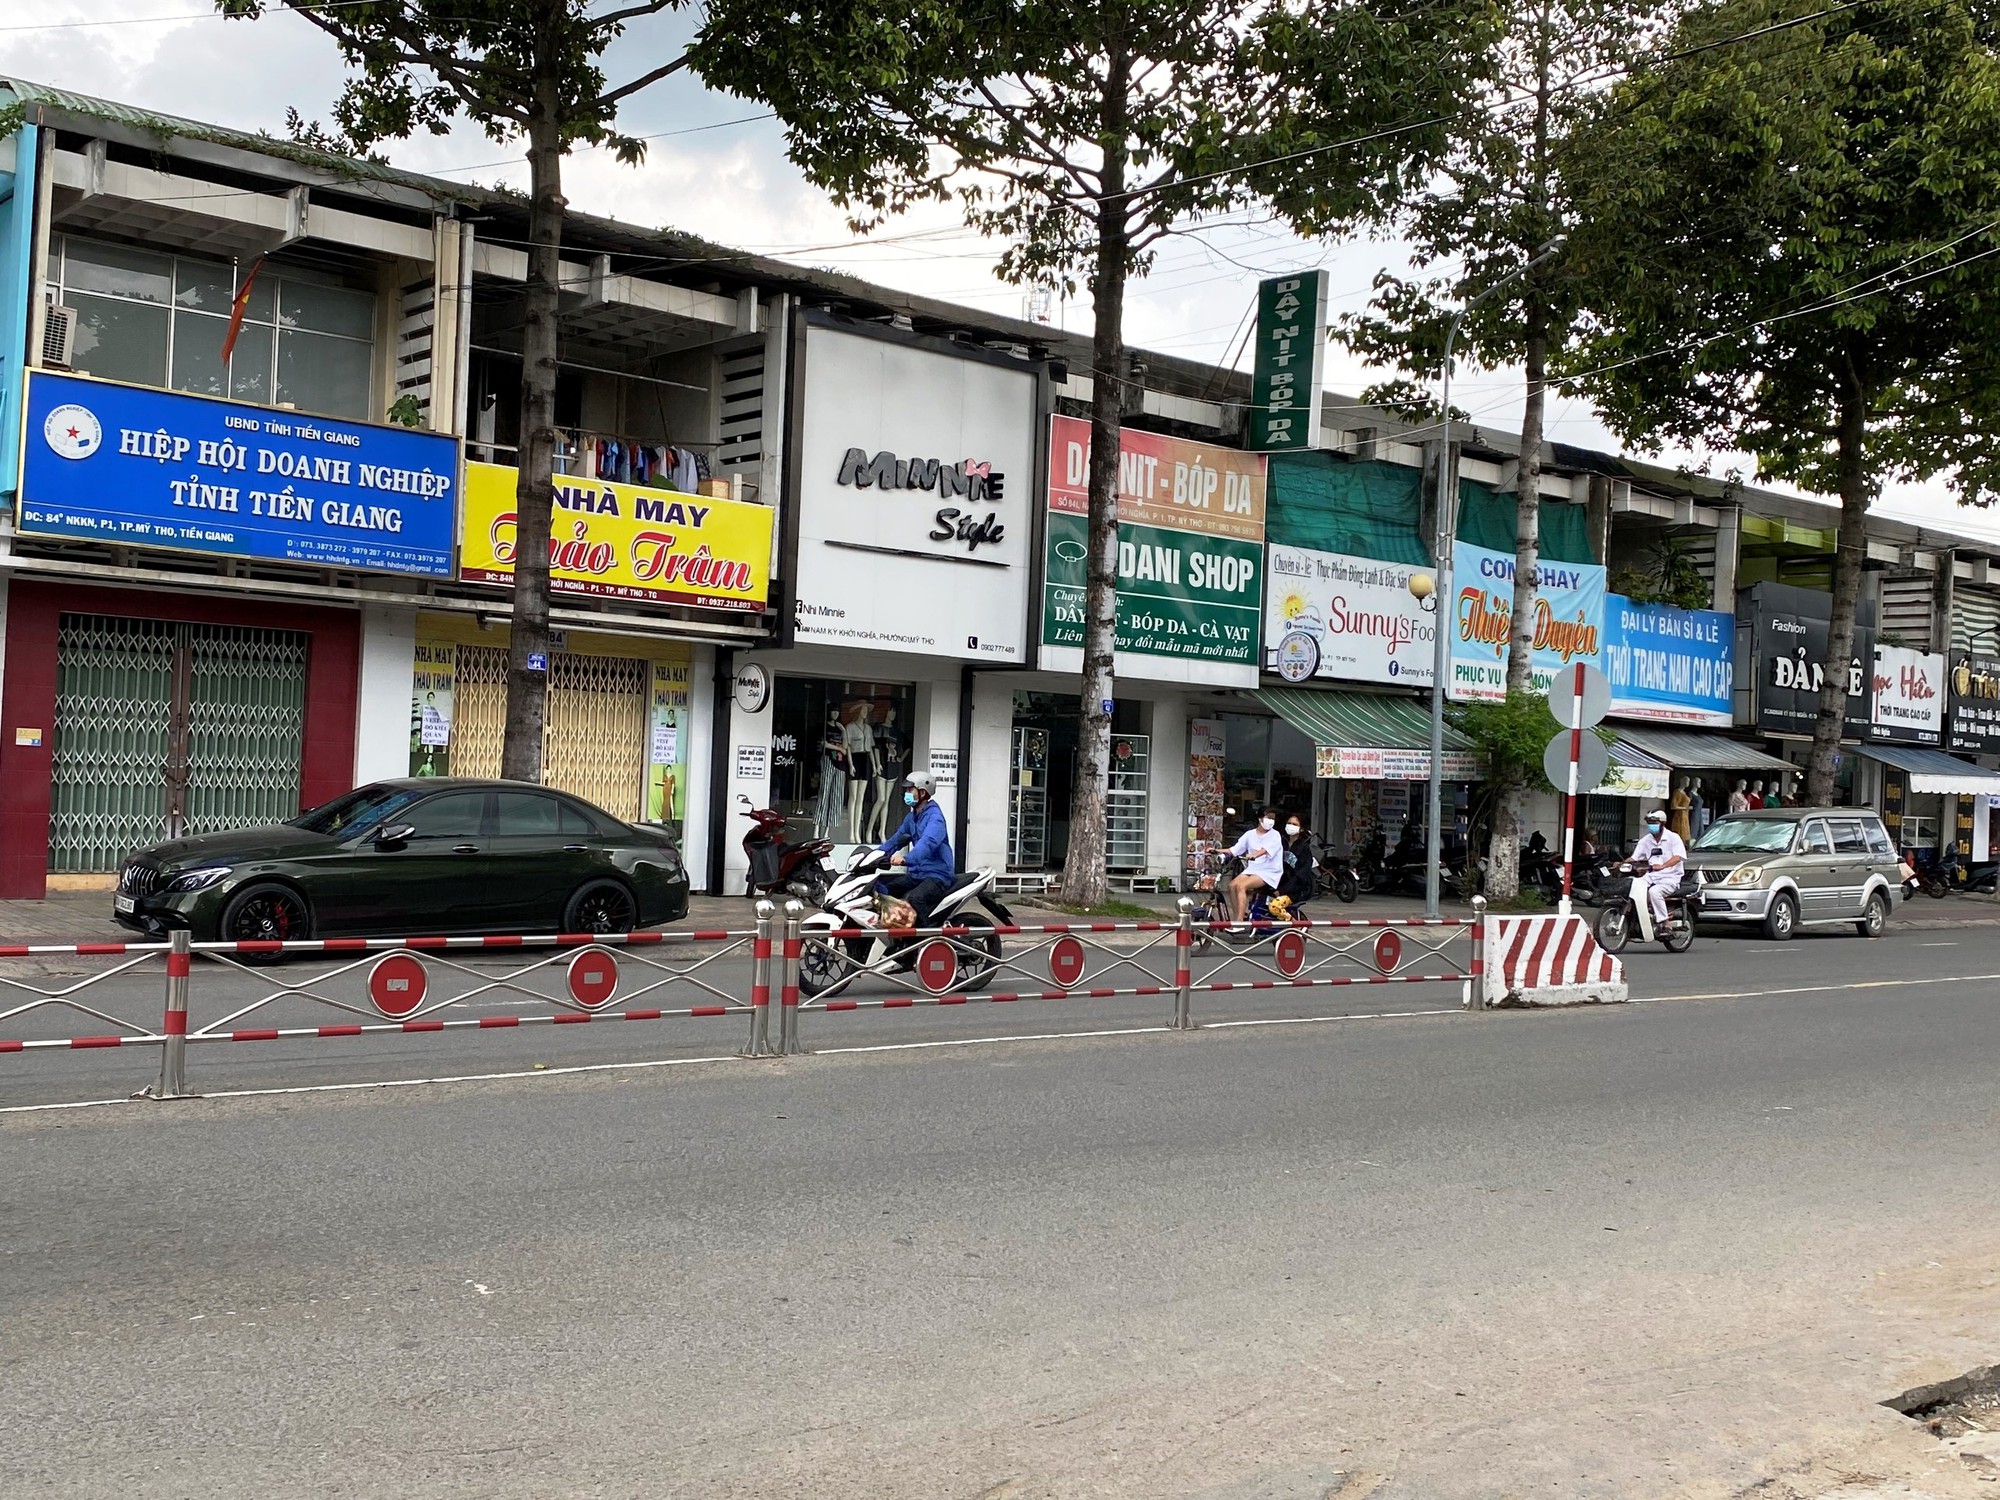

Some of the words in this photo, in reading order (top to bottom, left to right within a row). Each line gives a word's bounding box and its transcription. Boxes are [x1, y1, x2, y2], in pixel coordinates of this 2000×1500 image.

[1274, 279, 1300, 321] DÂY
[1272, 324, 1299, 367] NỊT
[1268, 372, 1294, 413] BÓP
[225, 416, 260, 431] UBND
[264, 419, 291, 436] TỈNH
[323, 432, 360, 447] GIANG
[1265, 418, 1291, 444] DA
[119, 428, 190, 464] HIỆP
[197, 437, 247, 474] HỘI
[257, 449, 352, 486] DOANH
[358, 464, 450, 501] NGHIỆP
[1120, 450, 1158, 507] NỊT
[1173, 454, 1218, 509] BÓP
[1223, 470, 1252, 516] DA
[170, 475, 240, 513] TỈNH
[249, 485, 315, 521] TIỀN
[321, 501, 403, 533] GIANG
[552, 486, 619, 516] NHÀ
[634, 496, 710, 528] MAY
[1057, 495, 1068, 507] SỐ
[25, 510, 43, 522] ĐC:
[66, 515, 98, 529] NKKN,
[100, 519, 117, 531] P1,
[120, 521, 151, 534] TP.MỸ
[154, 525, 177, 538] THO,
[205, 531, 234, 543] GIANG
[929, 508, 1005, 551] Style
[287, 550, 304, 558] Web:
[366, 559, 385, 568] Email:
[334, 544, 346, 553] 272
[369, 548, 381, 557] 207
[435, 556, 447, 564] 207
[490, 512, 618, 574] Tảo
[630, 530, 753, 591] Trâm
[1116, 541, 1180, 585] DANI
[1188, 551, 1254, 593] SHOP
[486, 572, 498, 581] ĐC:
[551, 578, 563, 588] HỞI
[591, 584, 599, 592] P1
[605, 585, 616, 594] TP.
[630, 589, 643, 597] THO
[649, 590, 657, 599] TG
[1274, 553, 1295, 573] Chuyên
[1316, 559, 1331, 582] Thực
[1331, 558, 1348, 581] Phẩm
[1349, 564, 1364, 589] Đông
[1364, 567, 1378, 589] Lạnh
[1378, 572, 1384, 586] &
[1385, 570, 1396, 592] Đặc
[1397, 569, 1407, 590] Sản
[803, 603, 817, 615] Nhi
[818, 605, 846, 619] Minnie
[1053, 589, 1087, 603] Chuyê
[811, 626, 827, 635] NAM
[921, 638, 935, 646] THO
[1055, 603, 1086, 622] DÂY
[1131, 611, 1164, 632] BÓP
[1167, 619, 1189, 635] DA
[1200, 619, 1220, 639] CÀ
[1223, 625, 1250, 644] VẠT
[1329, 596, 1411, 655] Sunny's
[1411, 619, 1435, 642] Foo
[1460, 587, 1512, 659] Thiệ
[1532, 598, 1599, 665] Duyên
[1621, 610, 1640, 634] ĐẠI
[1642, 610, 1656, 633] LÝ
[1659, 613, 1681, 637] BÁN
[1683, 615, 1694, 639] SỈ
[1696, 623, 1703, 641] &
[1706, 618, 1719, 643] LẺ
[1772, 619, 1807, 635] Fashion
[434, 647, 453, 664] MAY
[1054, 628, 1083, 642] Liên
[1115, 634, 1132, 649] hay
[1135, 634, 1153, 649] đổi
[1154, 635, 1180, 652] mẫu
[1182, 641, 1201, 655] mã
[1202, 642, 1223, 655] mới
[1224, 644, 1249, 659] nhất
[673, 666, 688, 682] MAY
[1400, 666, 1425, 678] Sunny's
[1425, 668, 1434, 678] Fo
[1455, 664, 1485, 686] PHỤC
[1488, 668, 1502, 688] VỤ
[1606, 634, 1631, 686] THỜI
[1633, 647, 1667, 691] TRANG
[1669, 653, 1691, 694] NAM
[1692, 656, 1712, 697] CAO
[1713, 646, 1733, 700] CẤP
[748, 689, 760, 699] Style
[1872, 674, 1893, 723] gọc
[1900, 665, 1936, 701] Hiền
[1880, 702, 1892, 716] THỜI
[1893, 706, 1910, 719] TRANG
[1910, 709, 1920, 720] CAO
[1921, 707, 1931, 721] CẤP
[774, 755, 796, 767] Style
